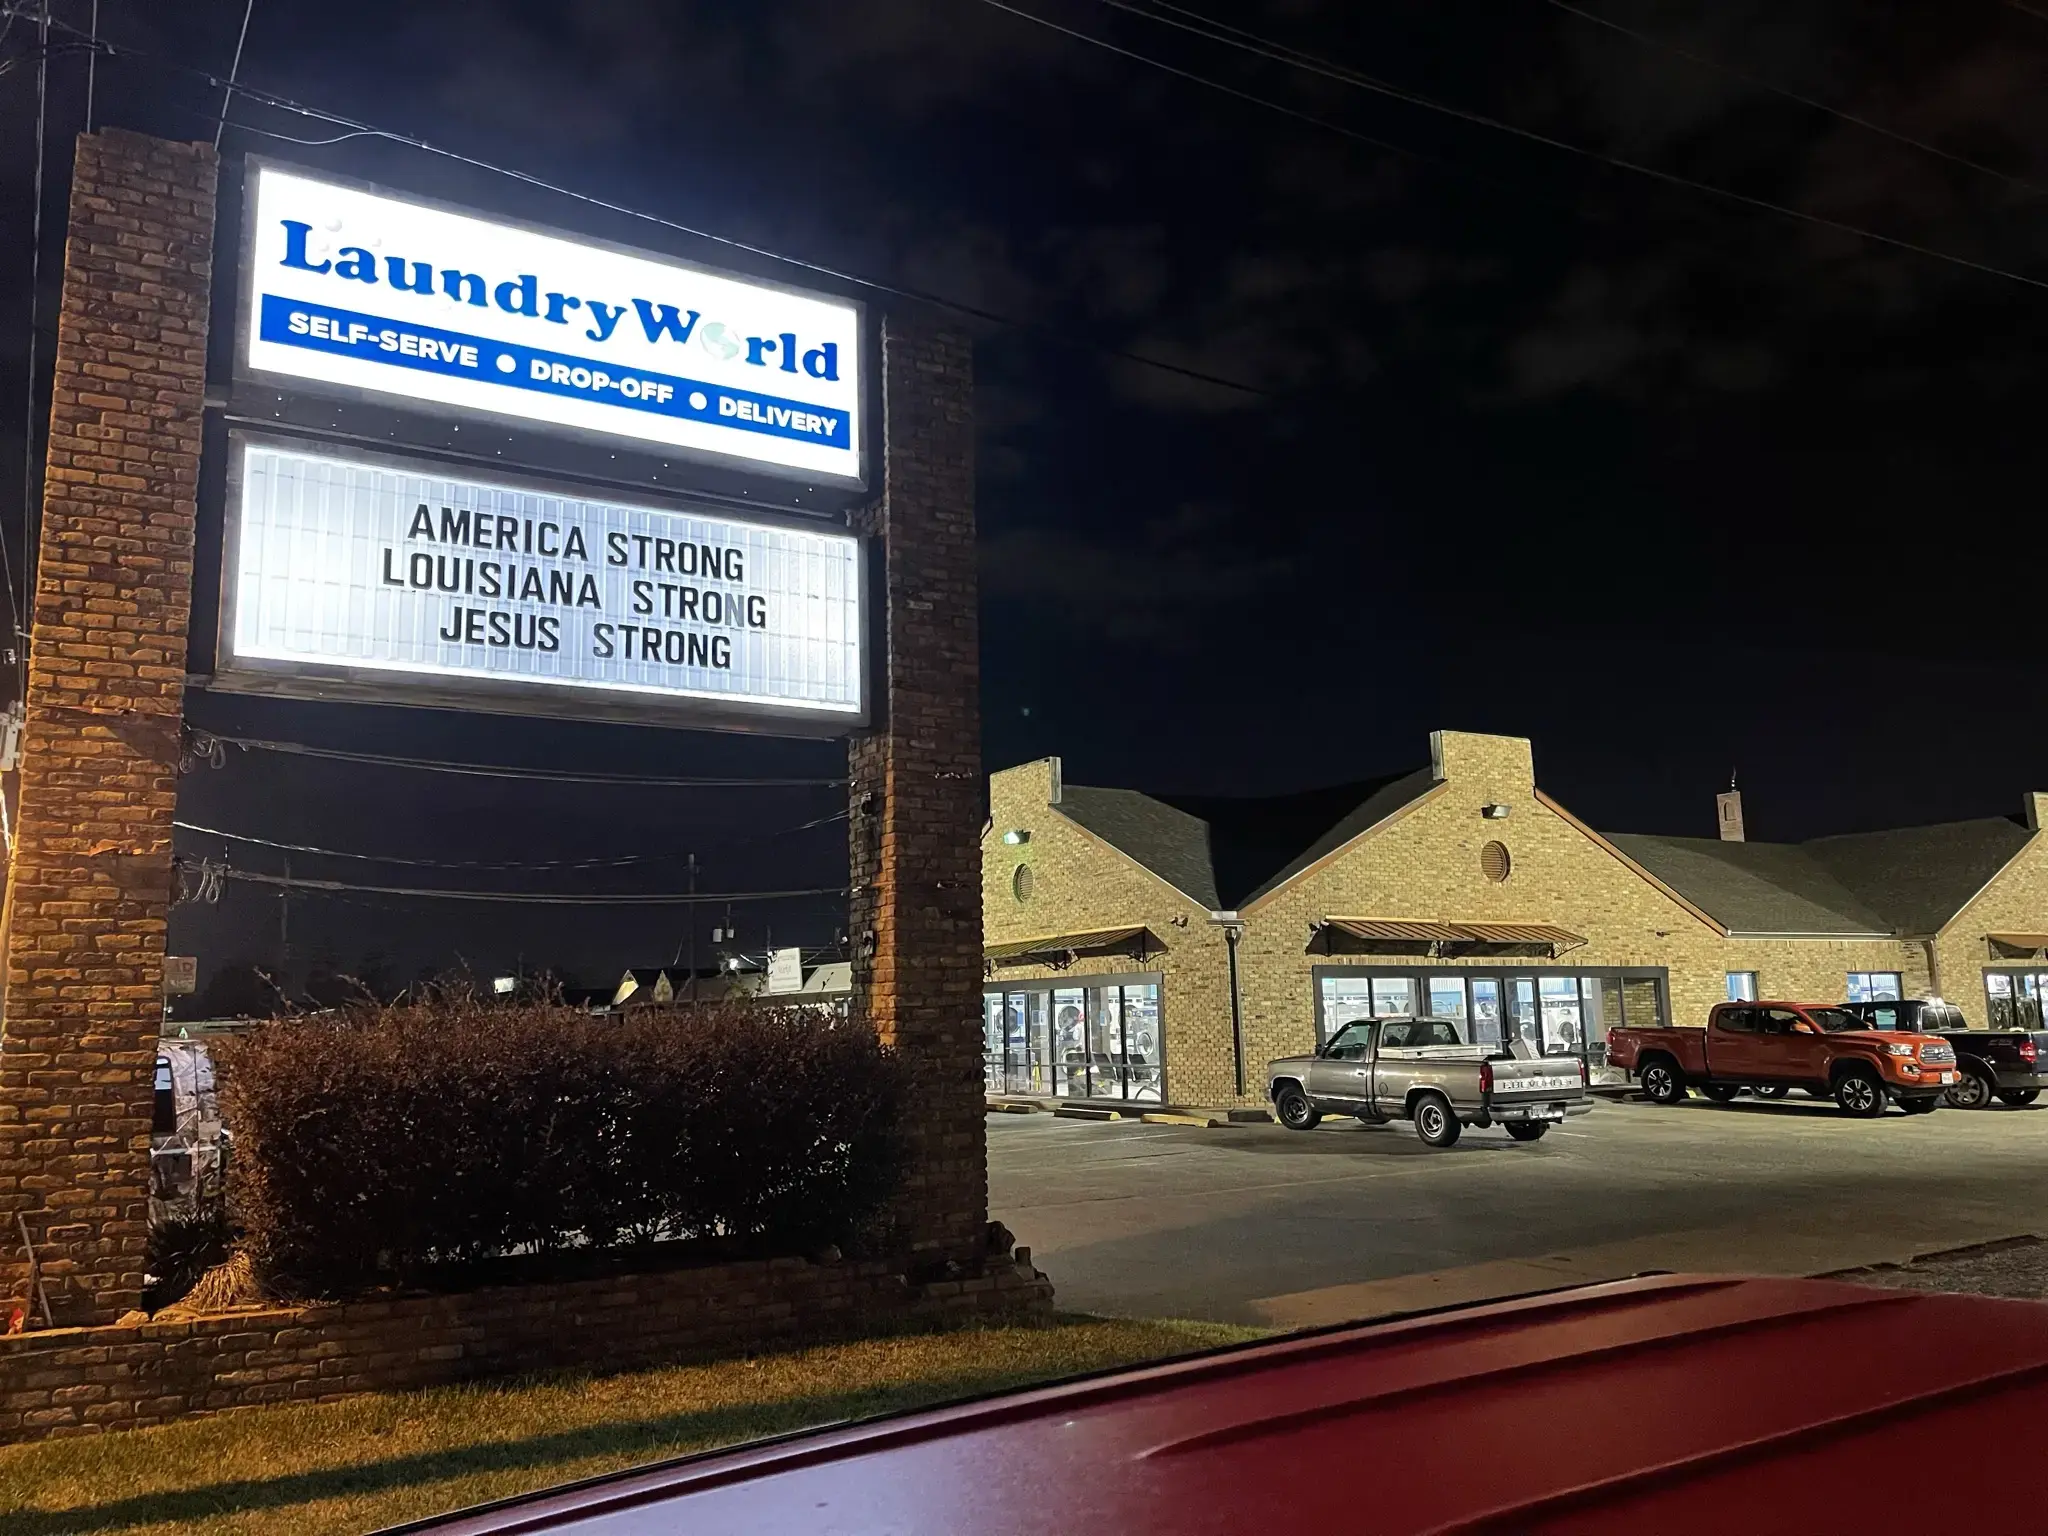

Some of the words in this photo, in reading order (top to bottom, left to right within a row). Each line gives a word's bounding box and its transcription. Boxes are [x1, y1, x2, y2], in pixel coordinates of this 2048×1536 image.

[289, 311, 479, 369] SELF-SERVE
[530, 360, 675, 404] DROP-OFF
[719, 397, 837, 438] DELIVERY
[408, 503, 589, 562] AMERICA
[608, 532, 744, 582] STRONG
[383, 548, 602, 610] LOUISIANA
[633, 581, 767, 629] STRONG
[441, 607, 560, 652] JESUS
[594, 624, 732, 669] STRONG
